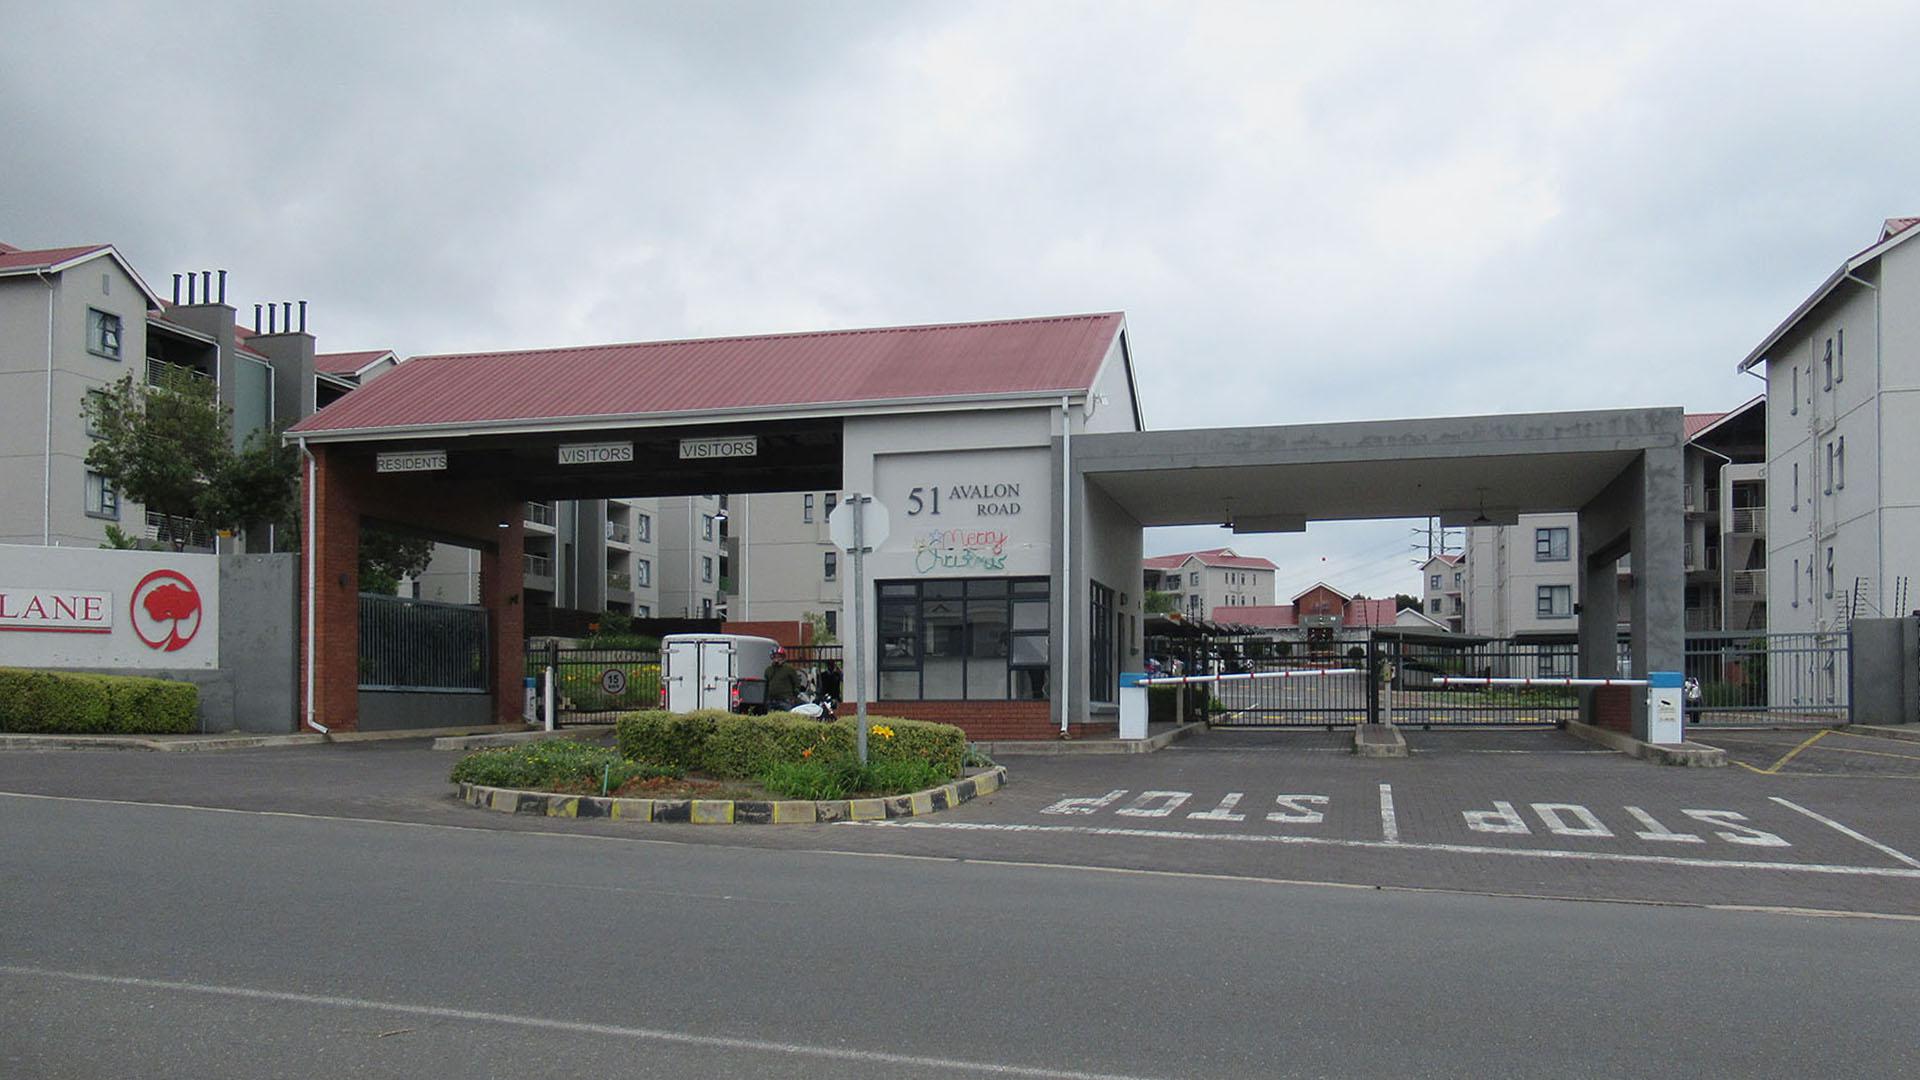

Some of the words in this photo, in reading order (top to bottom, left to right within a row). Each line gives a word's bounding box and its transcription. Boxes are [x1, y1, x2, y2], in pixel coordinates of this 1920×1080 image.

[561, 447, 631, 462] VISITORS
[679, 441, 754, 457] VISITORS
[377, 456, 447, 471] RESIDENTS
[907, 486, 941, 516] 51
[948, 483, 1020, 500] AVALON
[976, 502, 1021, 516] ROAD
[942, 528, 1008, 555] Merry
[0, 593, 104, 621] LANE
[608, 674, 620, 684] 15
[1039, 789, 1330, 824] STOP
[1462, 800, 1793, 847] STOP
